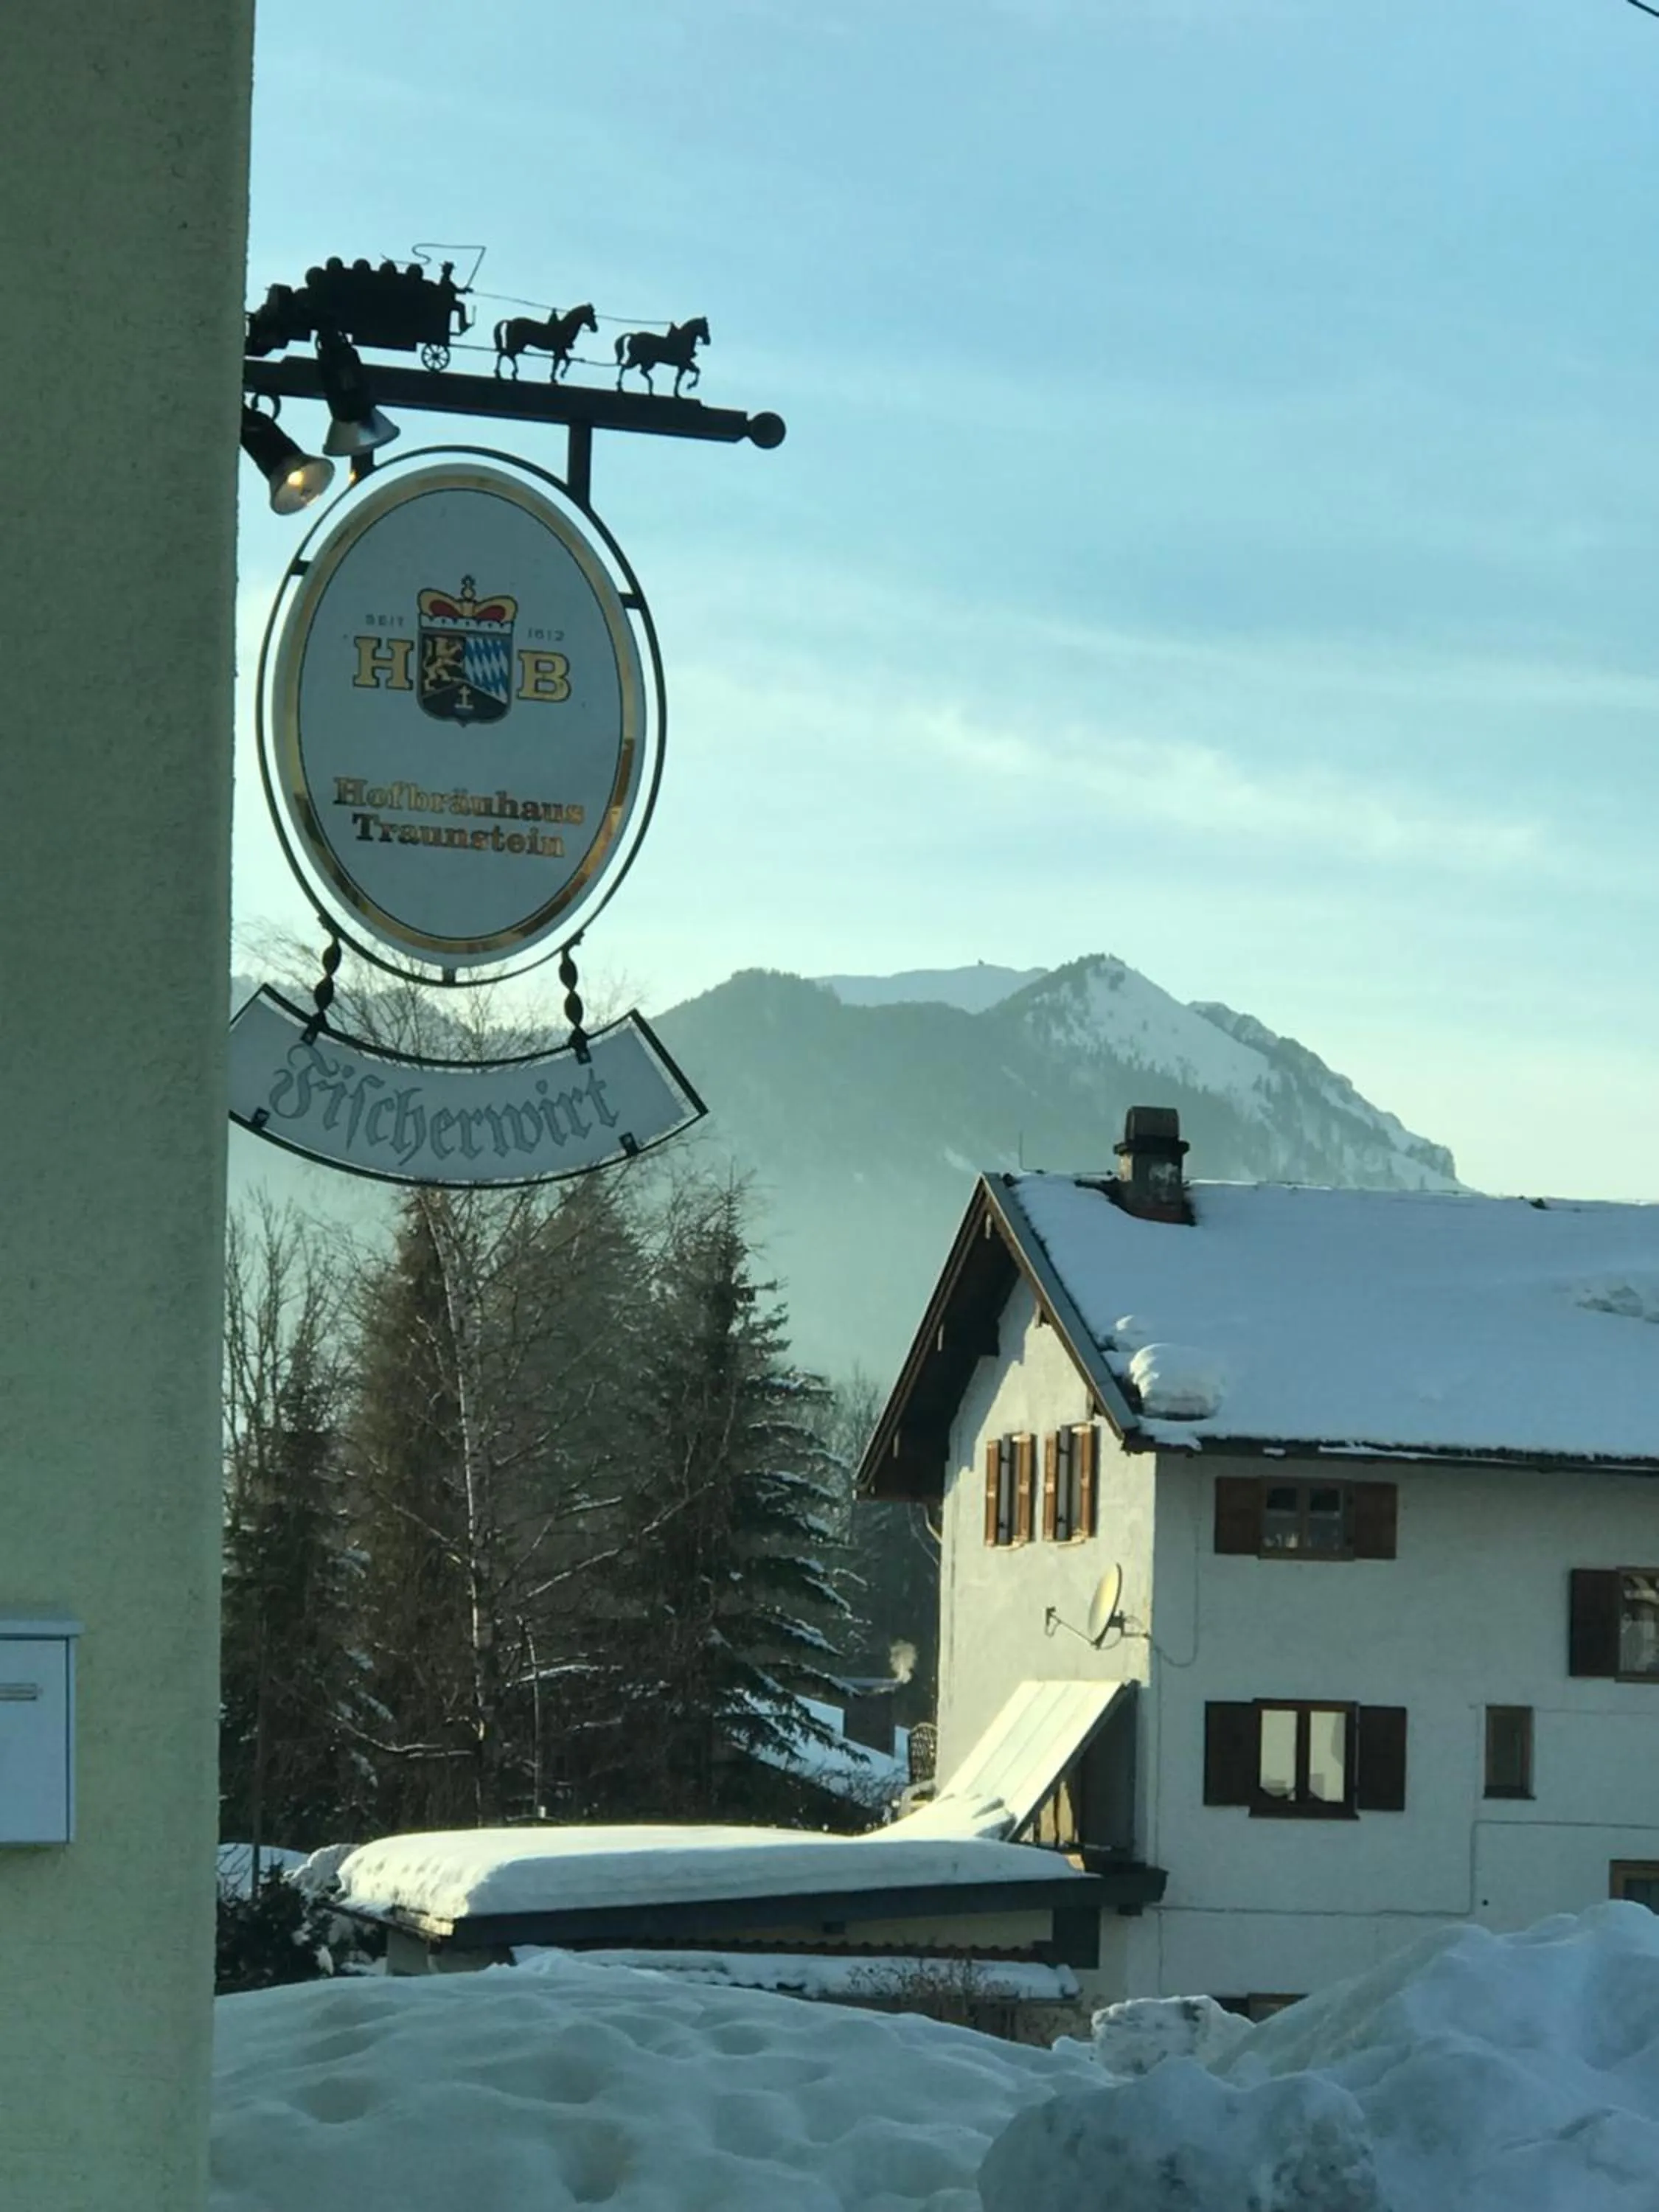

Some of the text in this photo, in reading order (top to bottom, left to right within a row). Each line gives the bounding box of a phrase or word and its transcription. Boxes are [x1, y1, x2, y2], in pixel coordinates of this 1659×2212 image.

[365, 613, 566, 641] SEIT 1612
[333, 776, 585, 826] Hofbräuhaus
[352, 813, 566, 858] Traunstein
